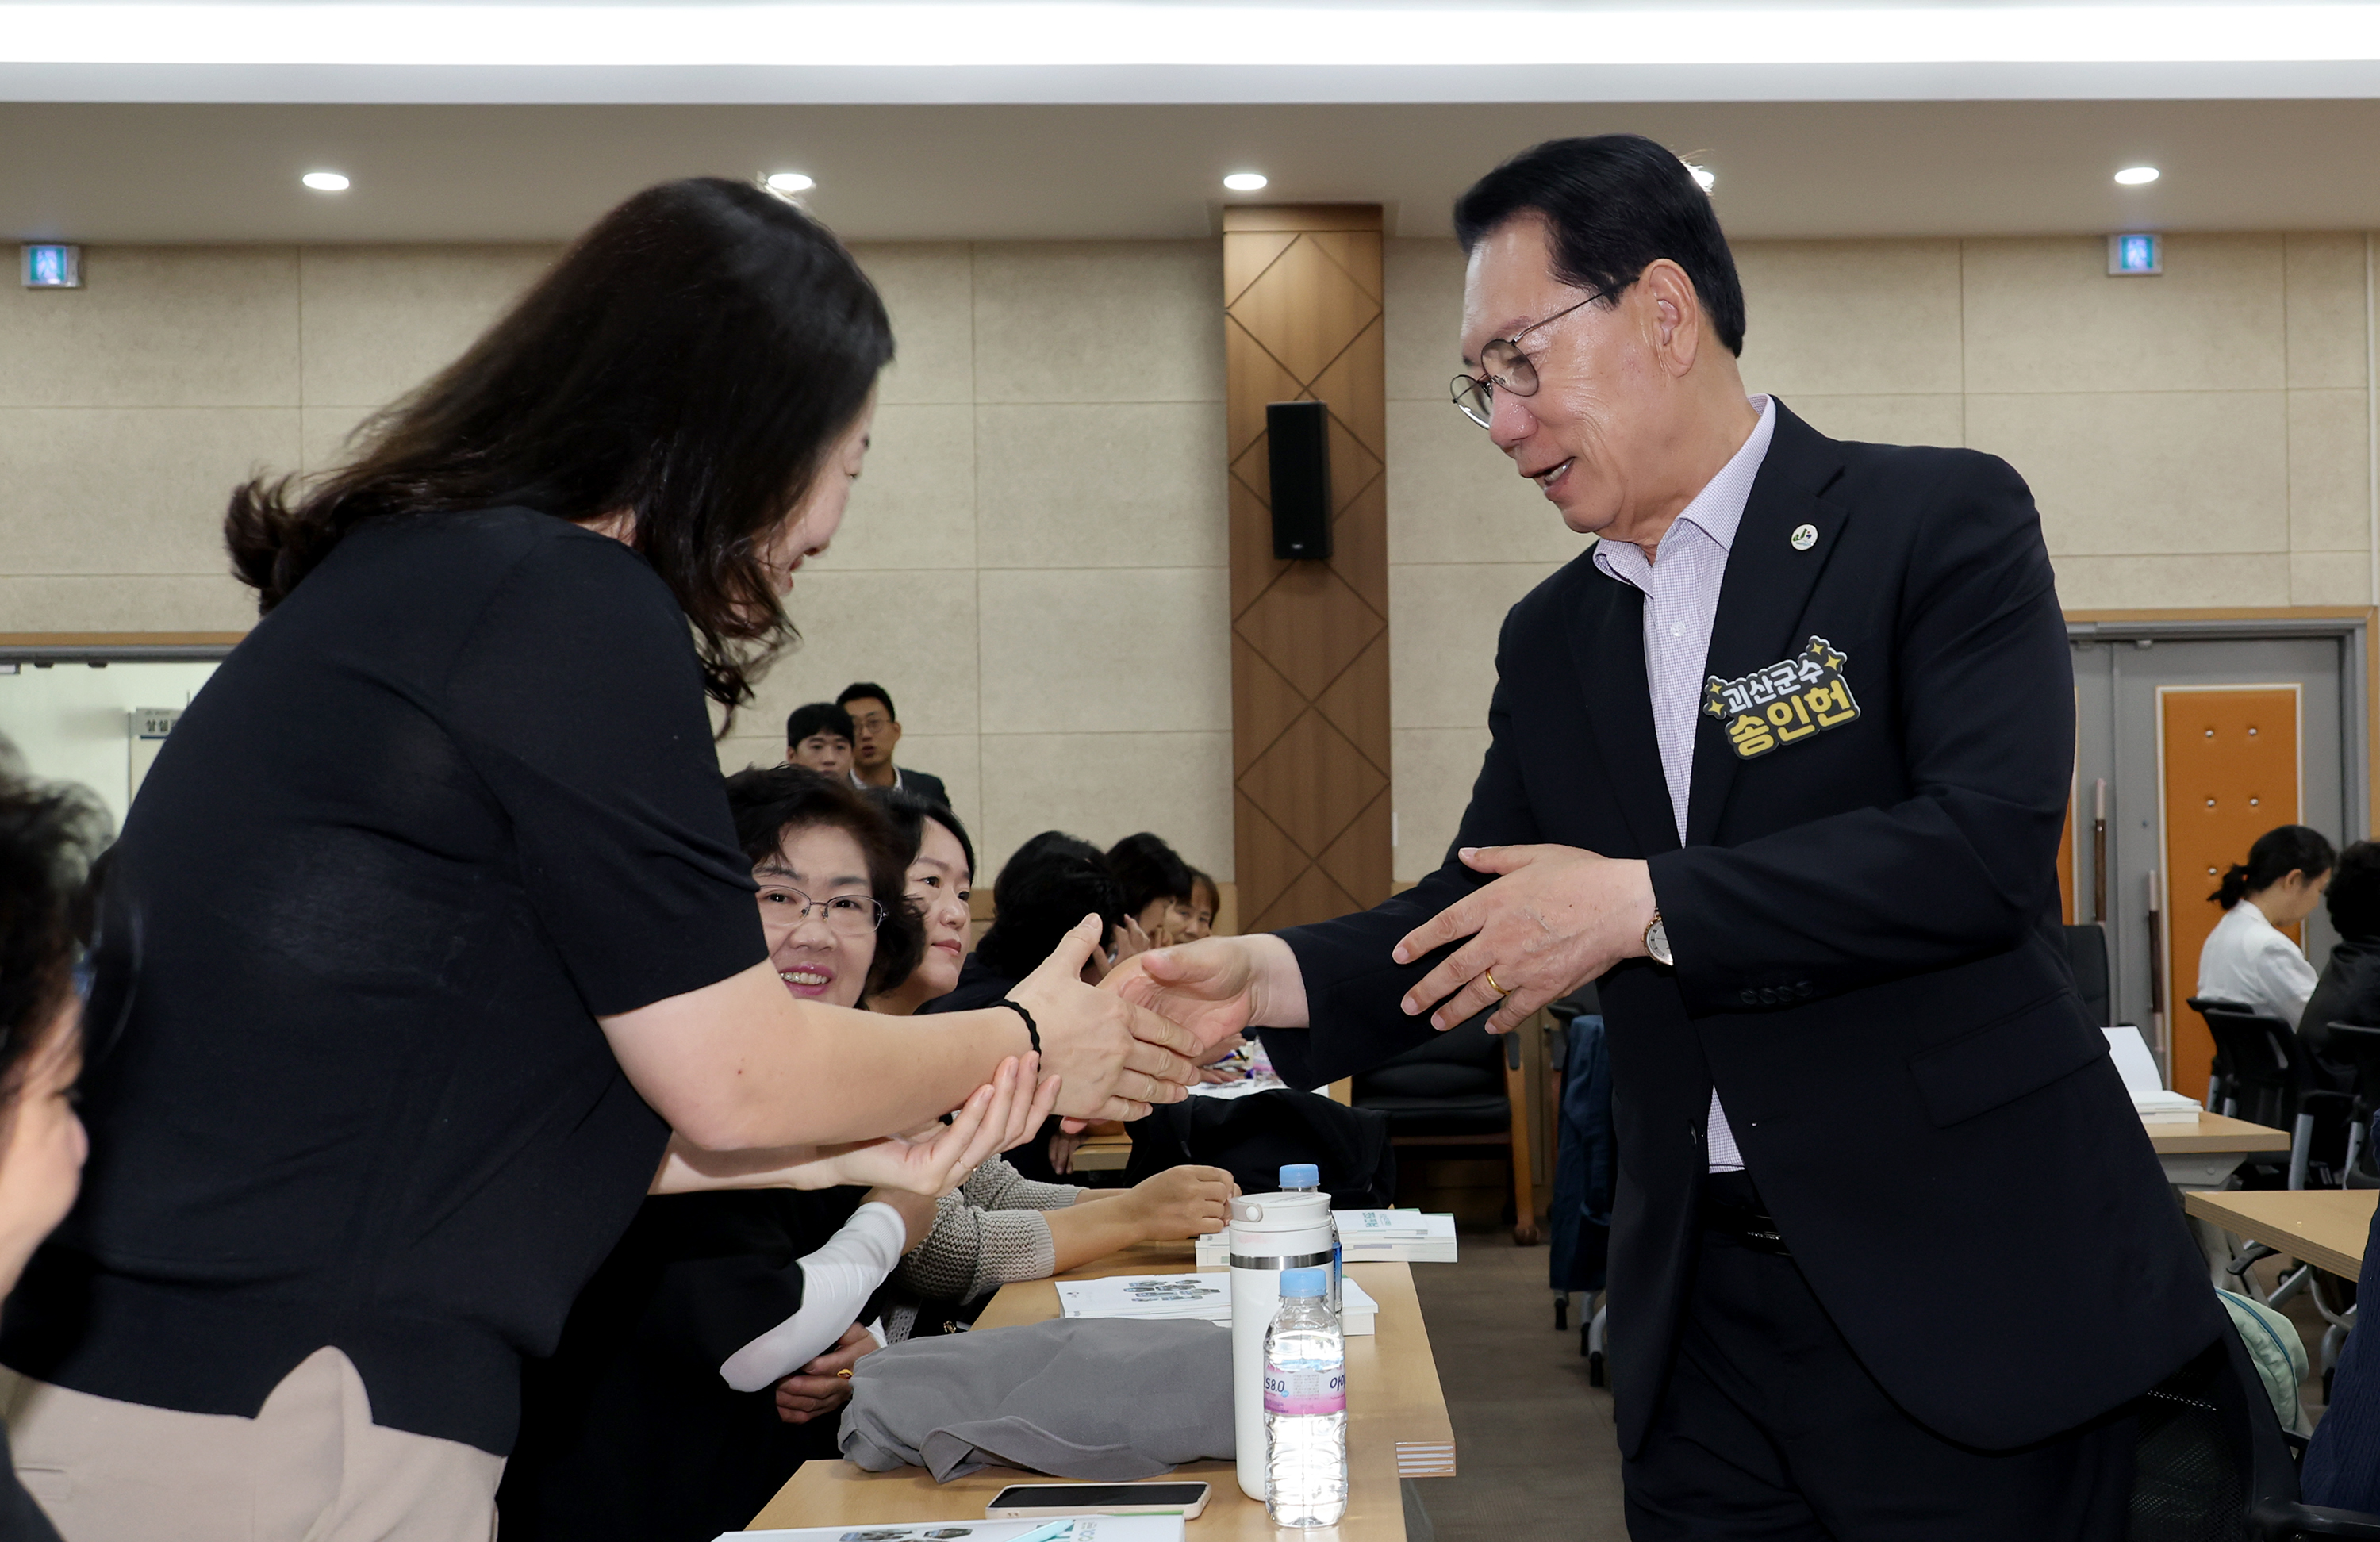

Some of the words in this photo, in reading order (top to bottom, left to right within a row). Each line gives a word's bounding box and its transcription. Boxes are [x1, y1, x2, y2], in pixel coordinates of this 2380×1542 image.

[1722, 659, 1824, 714] 괴산군수
[146, 719, 177, 732] 상설
[1729, 680, 1856, 757] 송인헌
